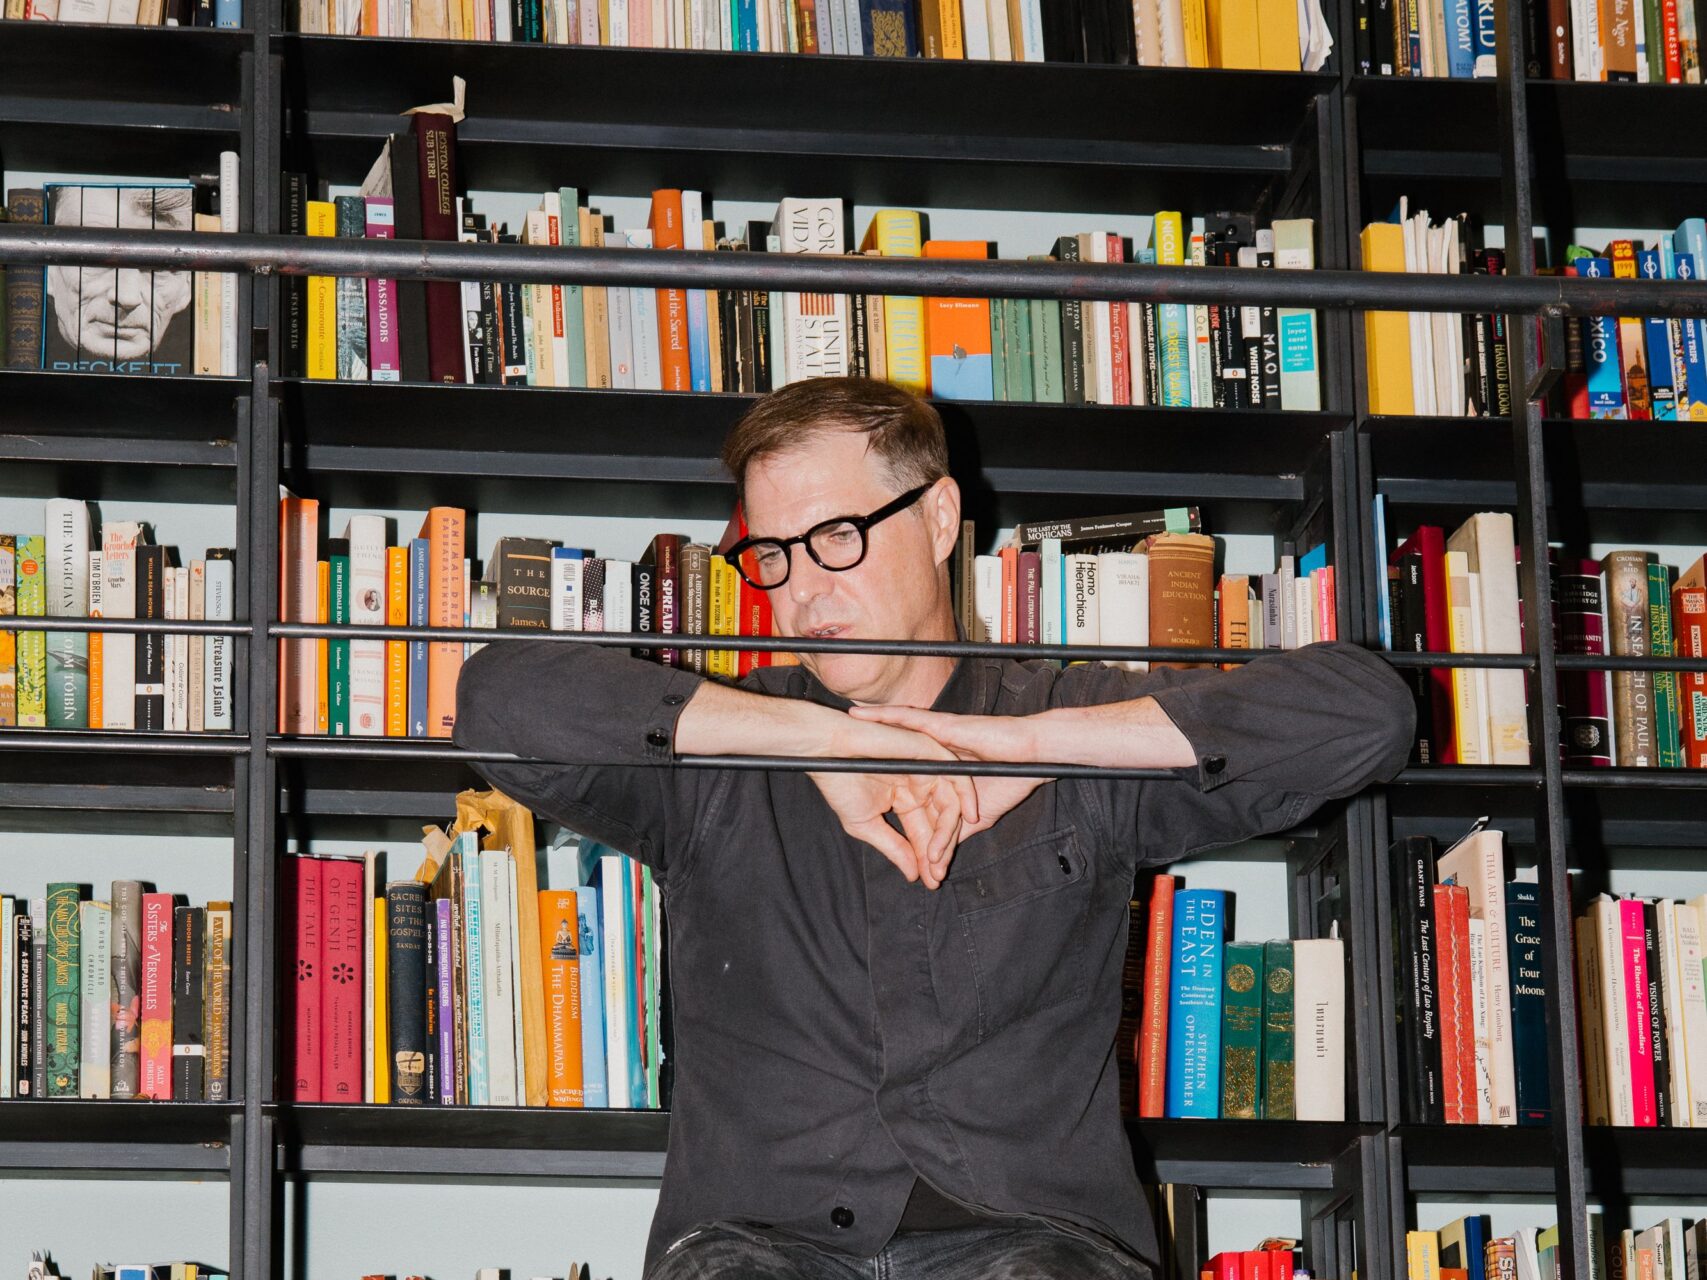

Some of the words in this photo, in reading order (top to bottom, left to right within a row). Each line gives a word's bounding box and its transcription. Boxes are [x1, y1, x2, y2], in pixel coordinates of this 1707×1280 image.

[1669, 29, 1678, 61] MESSY
[426, 130, 434, 148] SUB
[439, 131, 448, 169] BOSTON
[427, 151, 436, 178] TURRI
[440, 172, 450, 215] COLLEGE
[669, 303, 680, 318] the
[670, 320, 682, 350] Sacred
[1686, 319, 1695, 337] BEST
[1167, 322, 1179, 368] FOREST
[1263, 334, 1276, 374] MAO
[1688, 339, 1698, 363] TRIPS
[1250, 346, 1258, 374] WHITE
[1494, 344, 1508, 379] HAROLD
[1169, 372, 1181, 406] DARK
[1251, 376, 1260, 403] NOISE
[1266, 385, 1278, 396] II
[1497, 383, 1511, 414] BLOOM
[63, 511, 73, 537] THE
[63, 544, 74, 608] MAGICIAN
[90, 557, 101, 570] TIM
[515, 569, 545, 577] THE
[90, 573, 101, 603] O'BRIEN
[507, 586, 550, 597] SOURCE
[640, 573, 650, 604] ONCE
[1087, 561, 1097, 595] Homo
[1171, 581, 1199, 589] INDIAN
[1076, 562, 1086, 627] Hierarchicus
[1162, 591, 1207, 599] EDUCATION
[640, 607, 650, 631] AND
[213, 636, 225, 682] Treasure
[63, 675, 75, 720] TÓIBÍN
[213, 686, 225, 717] Island
[1635, 694, 1647, 712] OF
[1636, 717, 1649, 749] PAUL
[1417, 859, 1425, 883] GRANT
[1486, 853, 1496, 881] THAI
[330, 877, 340, 902] OF
[347, 880, 356, 911] THE
[1487, 884, 1497, 904] ART
[147, 903, 160, 941] SISTERS
[1185, 900, 1195, 921] THE
[1519, 916, 1535, 927] The
[213, 929, 222, 947] MAP
[329, 905, 340, 951] GENJI
[347, 916, 356, 952] TALE
[1200, 900, 1215, 958] EDEN
[1420, 920, 1429, 933] The
[1515, 933, 1540, 944] Grace
[213, 949, 222, 960] OF
[1181, 927, 1196, 977] EAST
[1421, 936, 1430, 950] Last
[1489, 922, 1500, 972] CULTURE
[1525, 953, 1533, 961] of
[147, 953, 160, 1010] VERSAILLES
[213, 962, 222, 980] THE
[552, 965, 564, 988] THE
[1203, 964, 1212, 977] IN
[1420, 953, 1431, 982] Century
[1519, 968, 1540, 977] Four
[213, 981, 222, 1015] WORLD
[570, 967, 579, 1019] BUDDHISM
[1422, 984, 1432, 992] of
[1424, 994, 1433, 1008] Lao
[1493, 984, 1502, 1006] Henry
[1515, 984, 1545, 996] Moons
[1649, 981, 1658, 1015] VISIONS
[552, 993, 565, 1078] DHAMMAPADA
[1423, 1011, 1434, 1039] Royalty
[1495, 1009, 1504, 1042] Ginsburg
[1652, 1017, 1659, 1028] OF
[1652, 1030, 1661, 1061] POWER
[1184, 1015, 1194, 1106] OPPENHEIMER
[1197, 1034, 1207, 1089] STEPHEN
